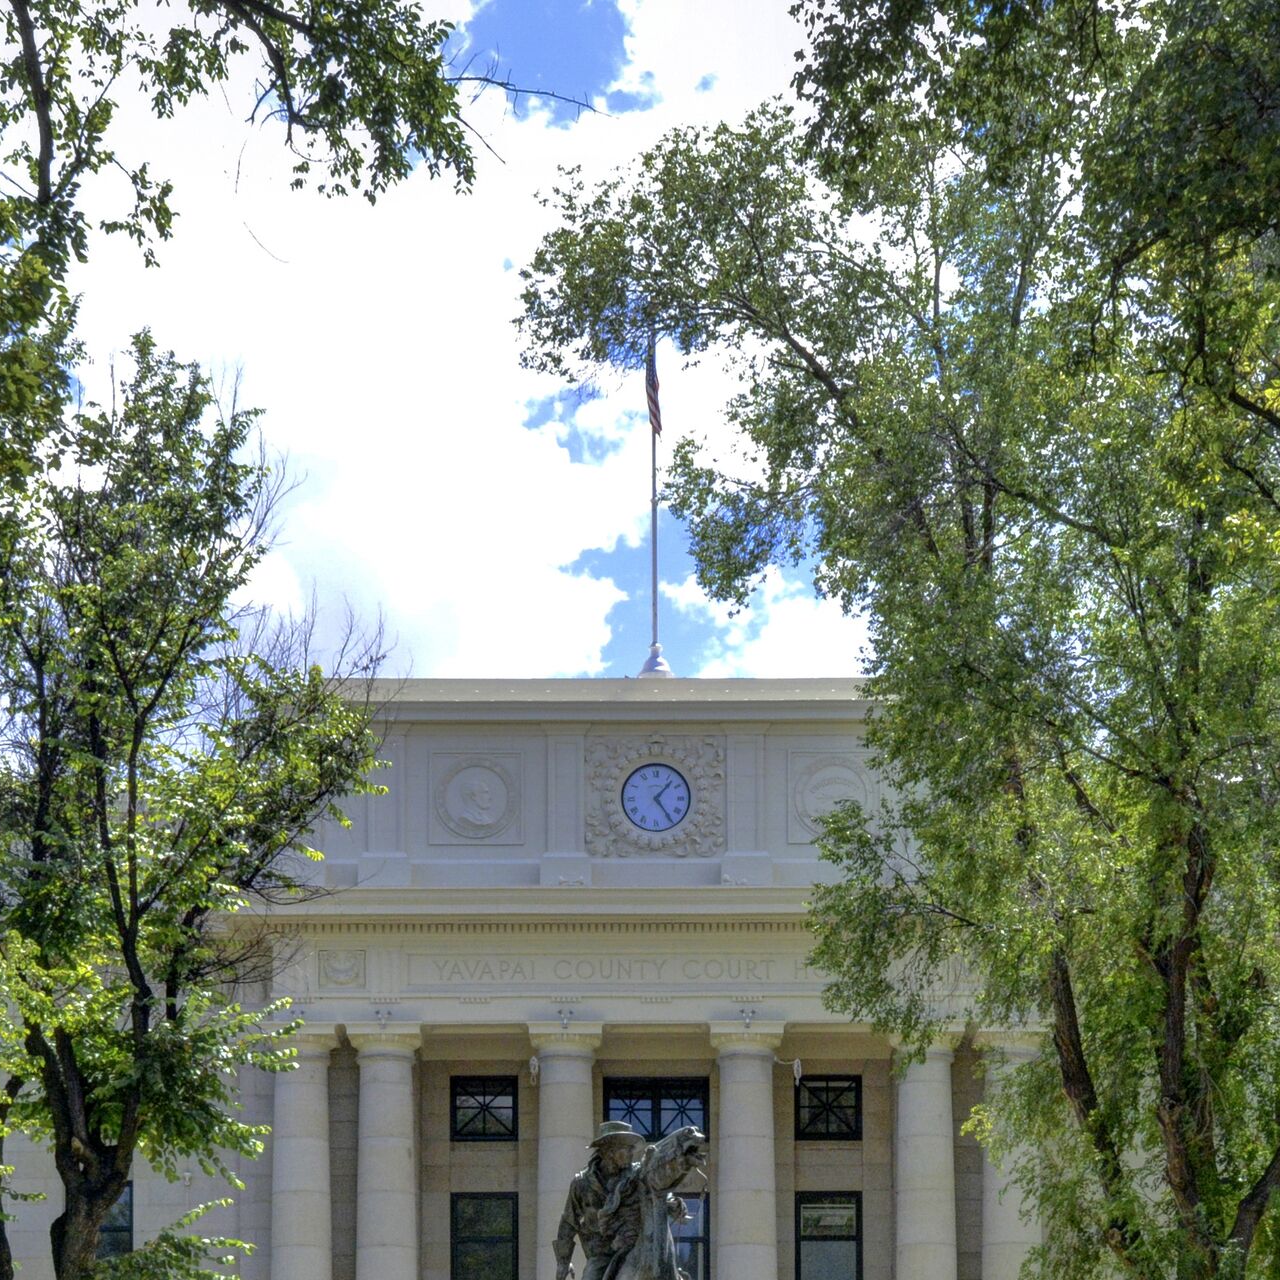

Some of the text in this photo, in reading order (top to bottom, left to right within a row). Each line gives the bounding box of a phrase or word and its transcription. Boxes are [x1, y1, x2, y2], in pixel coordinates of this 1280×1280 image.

[432, 959, 537, 981] YAVAPAI
[552, 959, 667, 981] COUNTY
[681, 958, 776, 981] COURT
